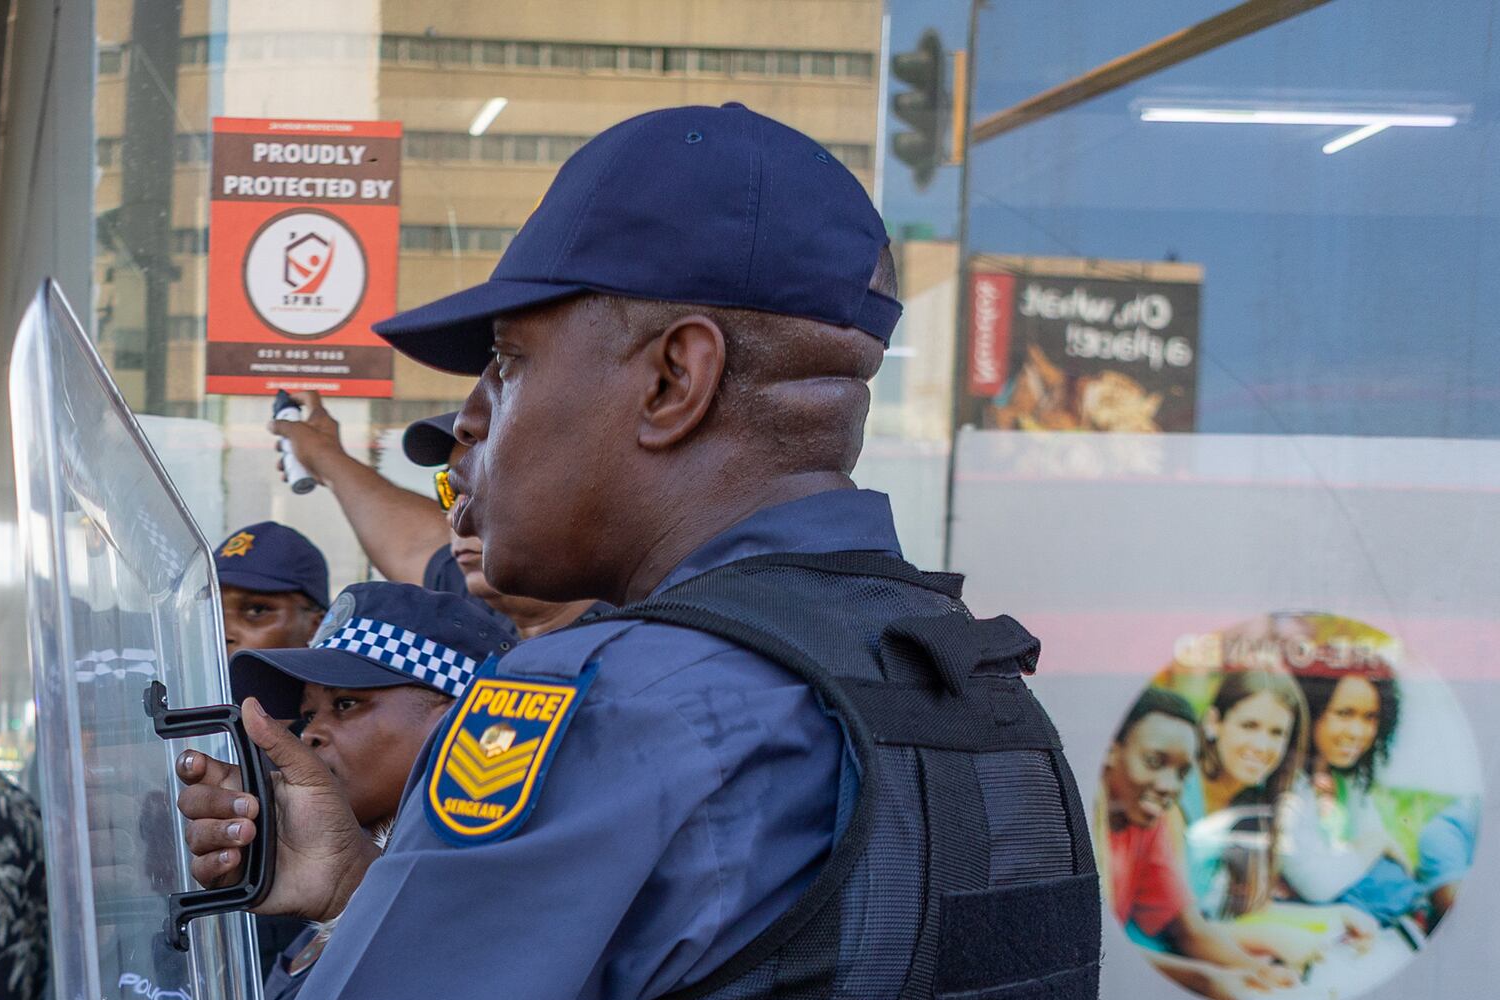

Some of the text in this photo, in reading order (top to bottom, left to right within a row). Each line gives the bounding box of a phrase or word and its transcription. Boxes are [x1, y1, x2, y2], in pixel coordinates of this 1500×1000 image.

[253, 142, 366, 165] PROUDLY
[223, 175, 393, 199] PROTECTED BY
[471, 688, 563, 722] POLICE
[443, 797, 506, 820] SERGEANT
